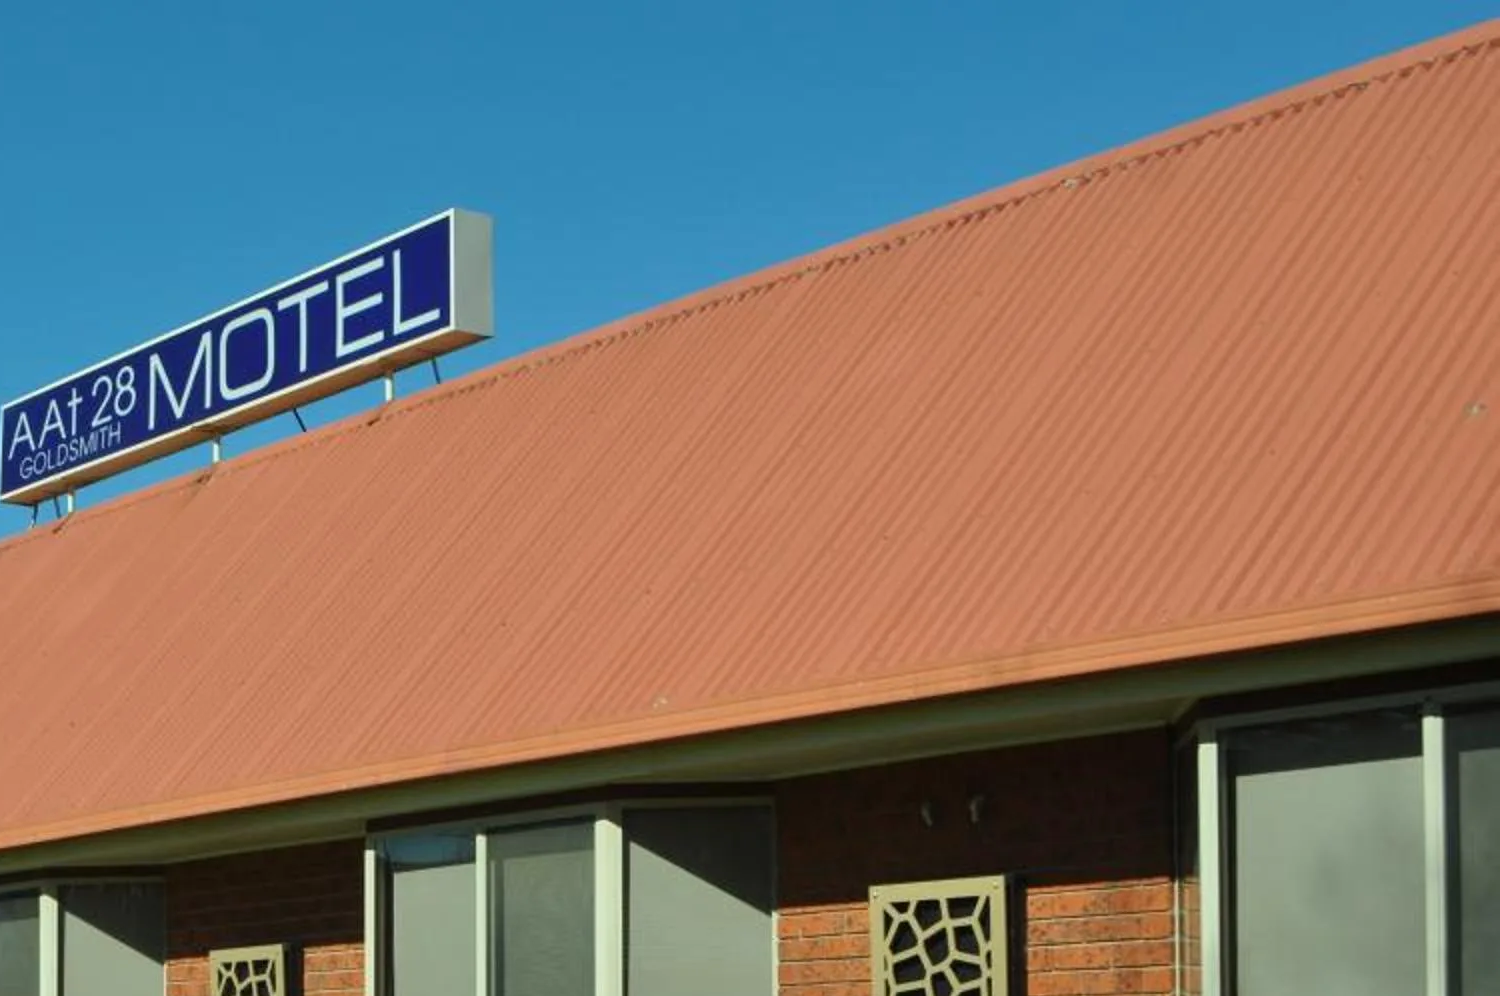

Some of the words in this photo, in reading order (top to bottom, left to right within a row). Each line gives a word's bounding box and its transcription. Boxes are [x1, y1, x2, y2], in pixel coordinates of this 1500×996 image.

[147, 248, 441, 431] MOTEL
[91, 365, 137, 428] 28
[19, 421, 122, 480] GOLDSMITH
